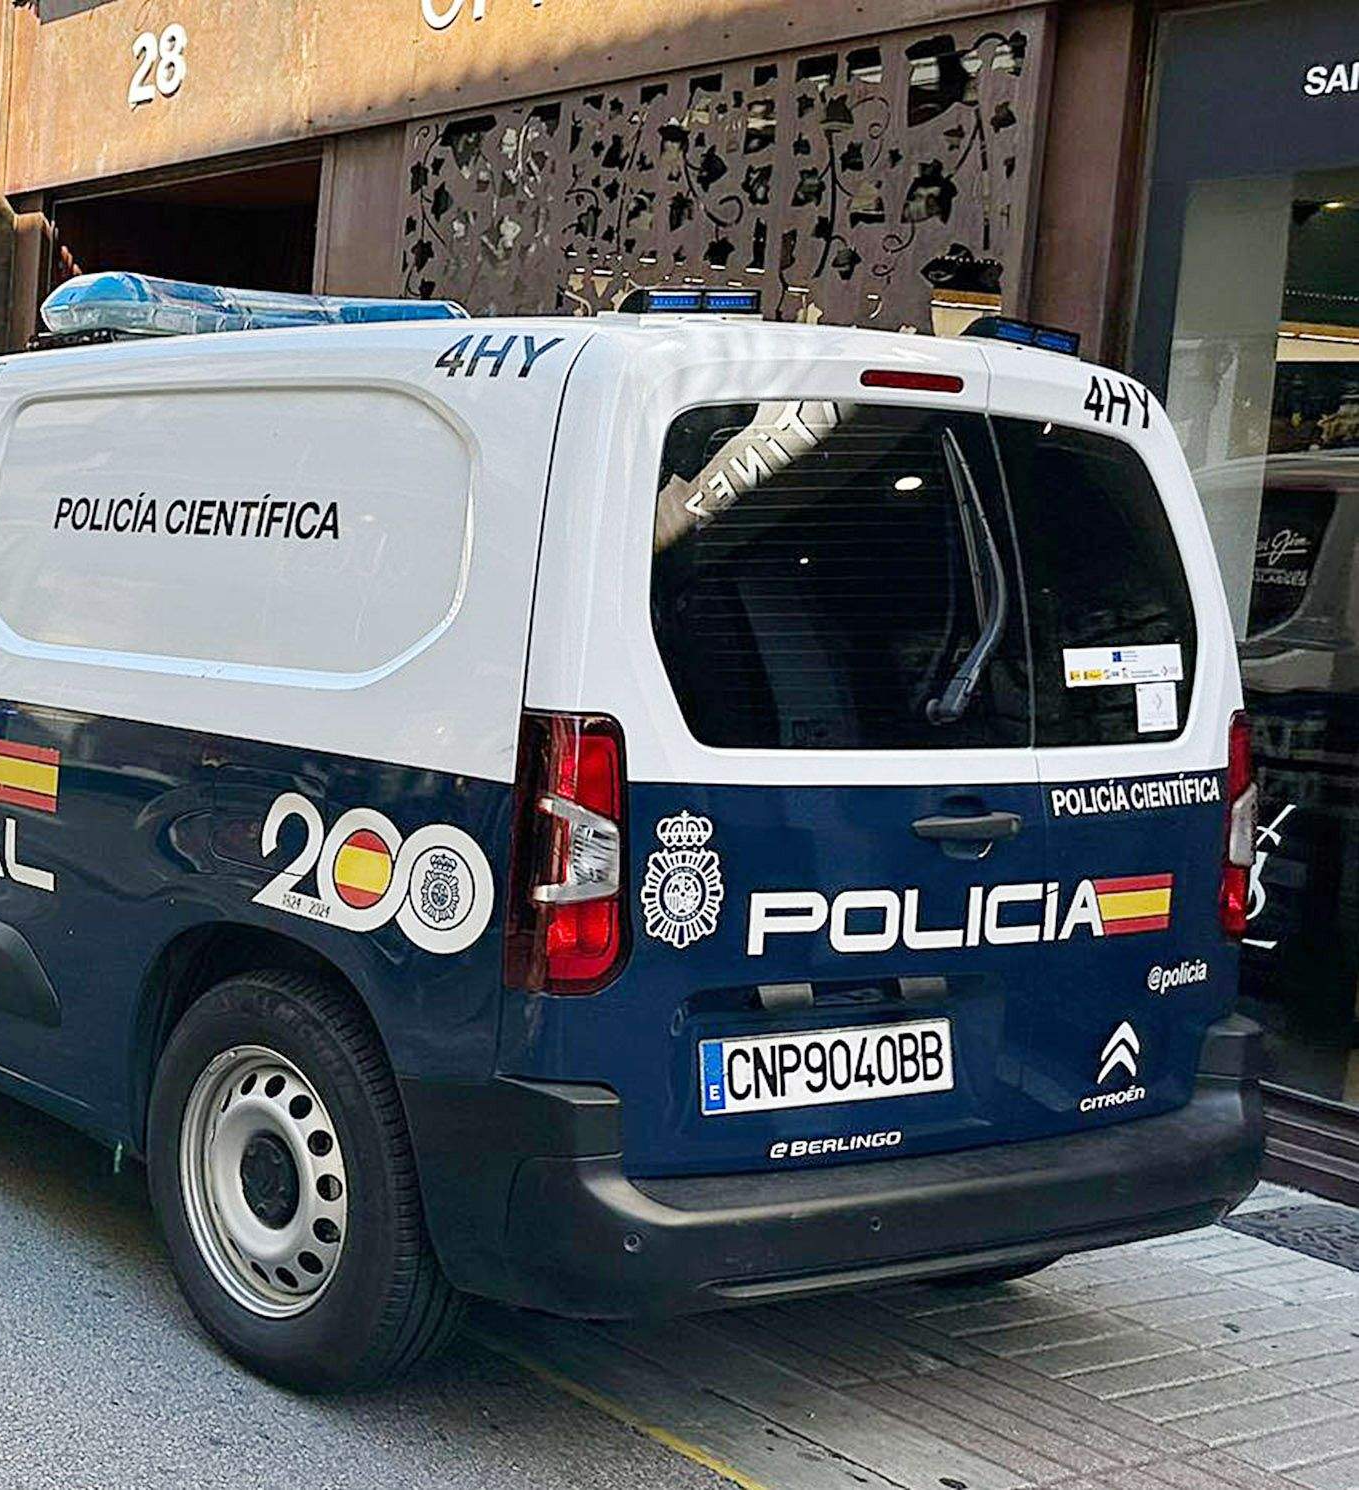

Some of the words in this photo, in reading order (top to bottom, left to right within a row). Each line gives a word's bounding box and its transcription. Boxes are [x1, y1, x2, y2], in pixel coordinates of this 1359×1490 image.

[128, 22, 188, 103] 28
[435, 334, 565, 378] 4HY
[1084, 375, 1150, 429] 4HY
[54, 491, 157, 533] POLICÍA
[165, 493, 340, 540] CIENTÍFICA
[1051, 780, 1131, 816] POLICÍA
[1130, 773, 1221, 810] CIENTÍFICA
[251, 791, 495, 955] 200
[709, 1084, 721, 1101] E
[727, 1031, 944, 1101] CNP9040BB
[790, 1131, 902, 1158] BERLINGO
